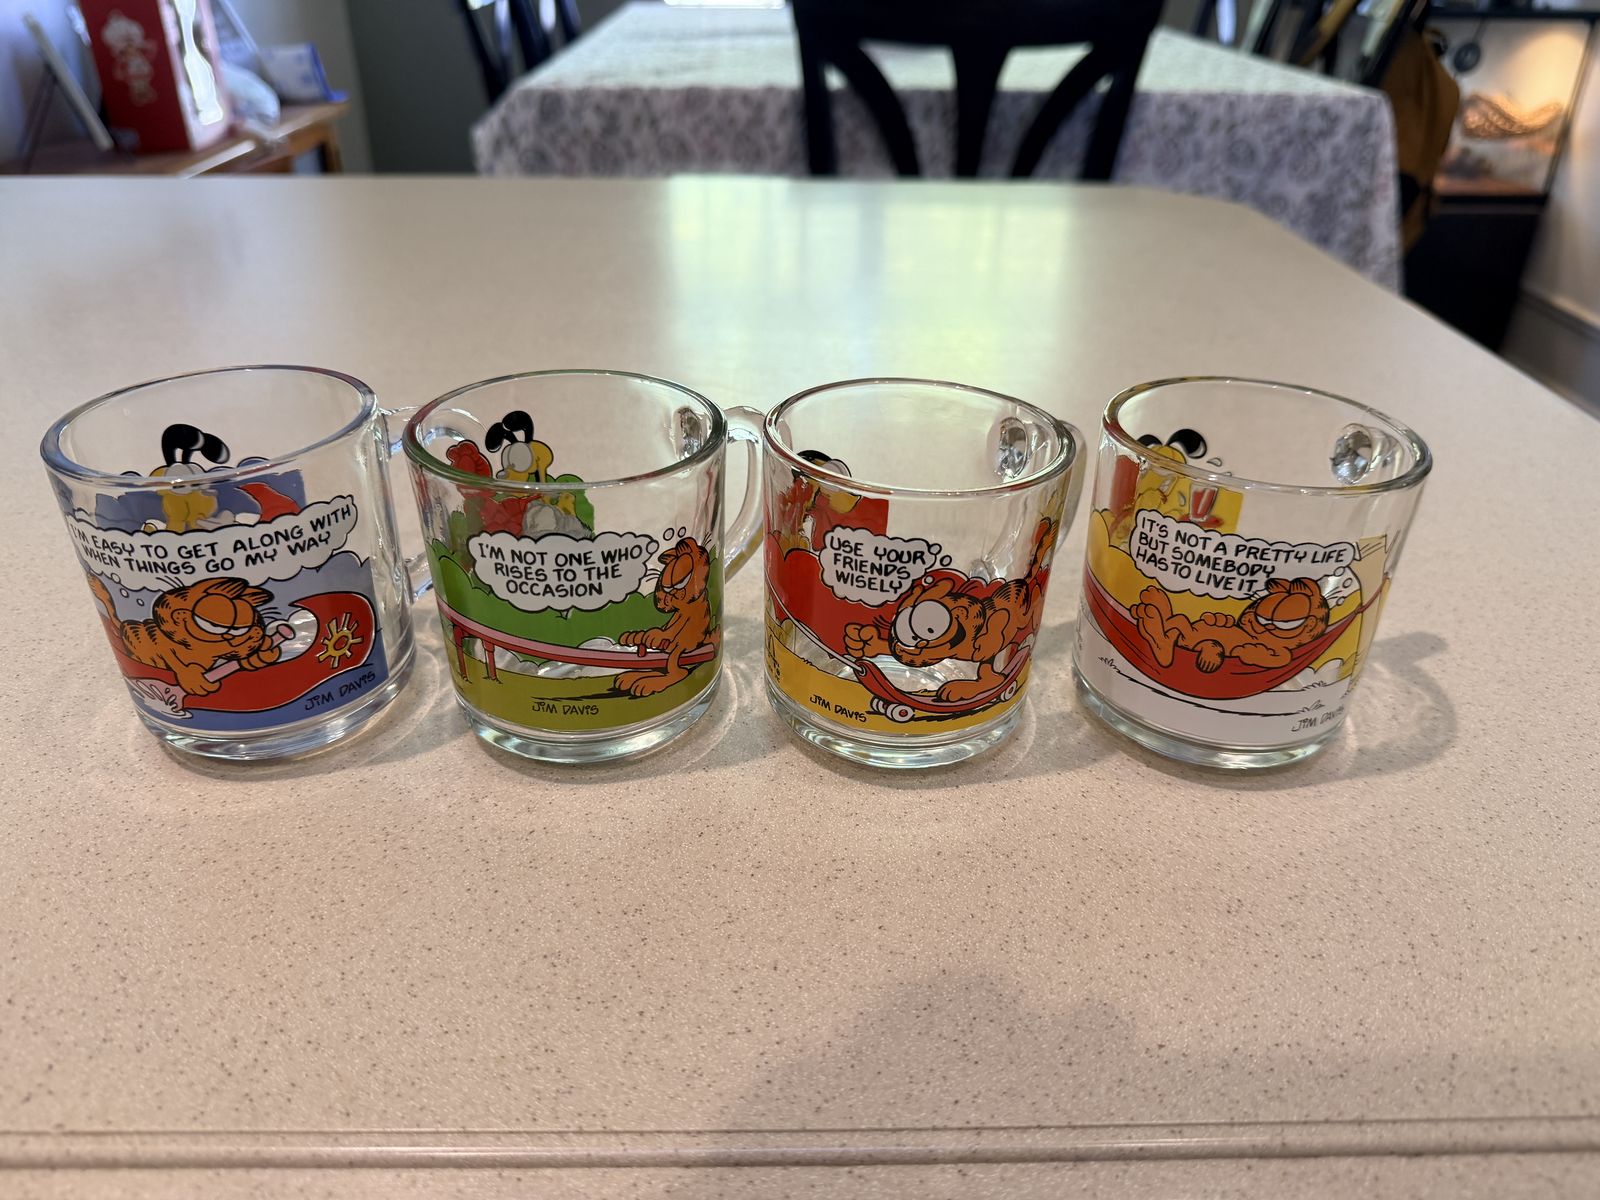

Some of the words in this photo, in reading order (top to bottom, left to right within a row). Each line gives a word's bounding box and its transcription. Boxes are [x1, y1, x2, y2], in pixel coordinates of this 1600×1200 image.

[70, 523, 90, 545] I'M
[94, 538, 134, 555] EASY
[141, 545, 169, 559] TO
[177, 542, 218, 558] GET
[233, 525, 304, 551] ALONG
[309, 504, 352, 536] WITH
[1142, 517, 1169, 538] IT'S
[1175, 530, 1212, 548] NOT
[1214, 542, 1228, 556] A
[1235, 545, 1307, 563] PRETTY
[1311, 549, 1347, 564] LIFE
[81, 543, 121, 569] WHEN
[124, 558, 195, 575] THINGS
[206, 557, 234, 572] GO
[245, 548, 278, 566] MY
[290, 531, 332, 555] WAY
[478, 542, 505, 562] I'M
[511, 549, 547, 565] NOT
[555, 551, 596, 567] ONE
[601, 545, 642, 562] WHO
[830, 536, 864, 557] USE
[874, 546, 926, 565] YOUR
[1139, 531, 1170, 551] BUT
[1172, 546, 1275, 578] SOMEBODY
[495, 562, 547, 582] RISES
[553, 567, 577, 582] TO
[584, 564, 623, 580] THE
[834, 553, 911, 580] FRIENDS
[1136, 549, 1169, 571] HAS
[1171, 563, 1191, 579] TO
[1195, 570, 1233, 590] LIVE
[1238, 579, 1257, 592] IT
[506, 580, 603, 597] OCCASION
[836, 570, 902, 594] WISELY
